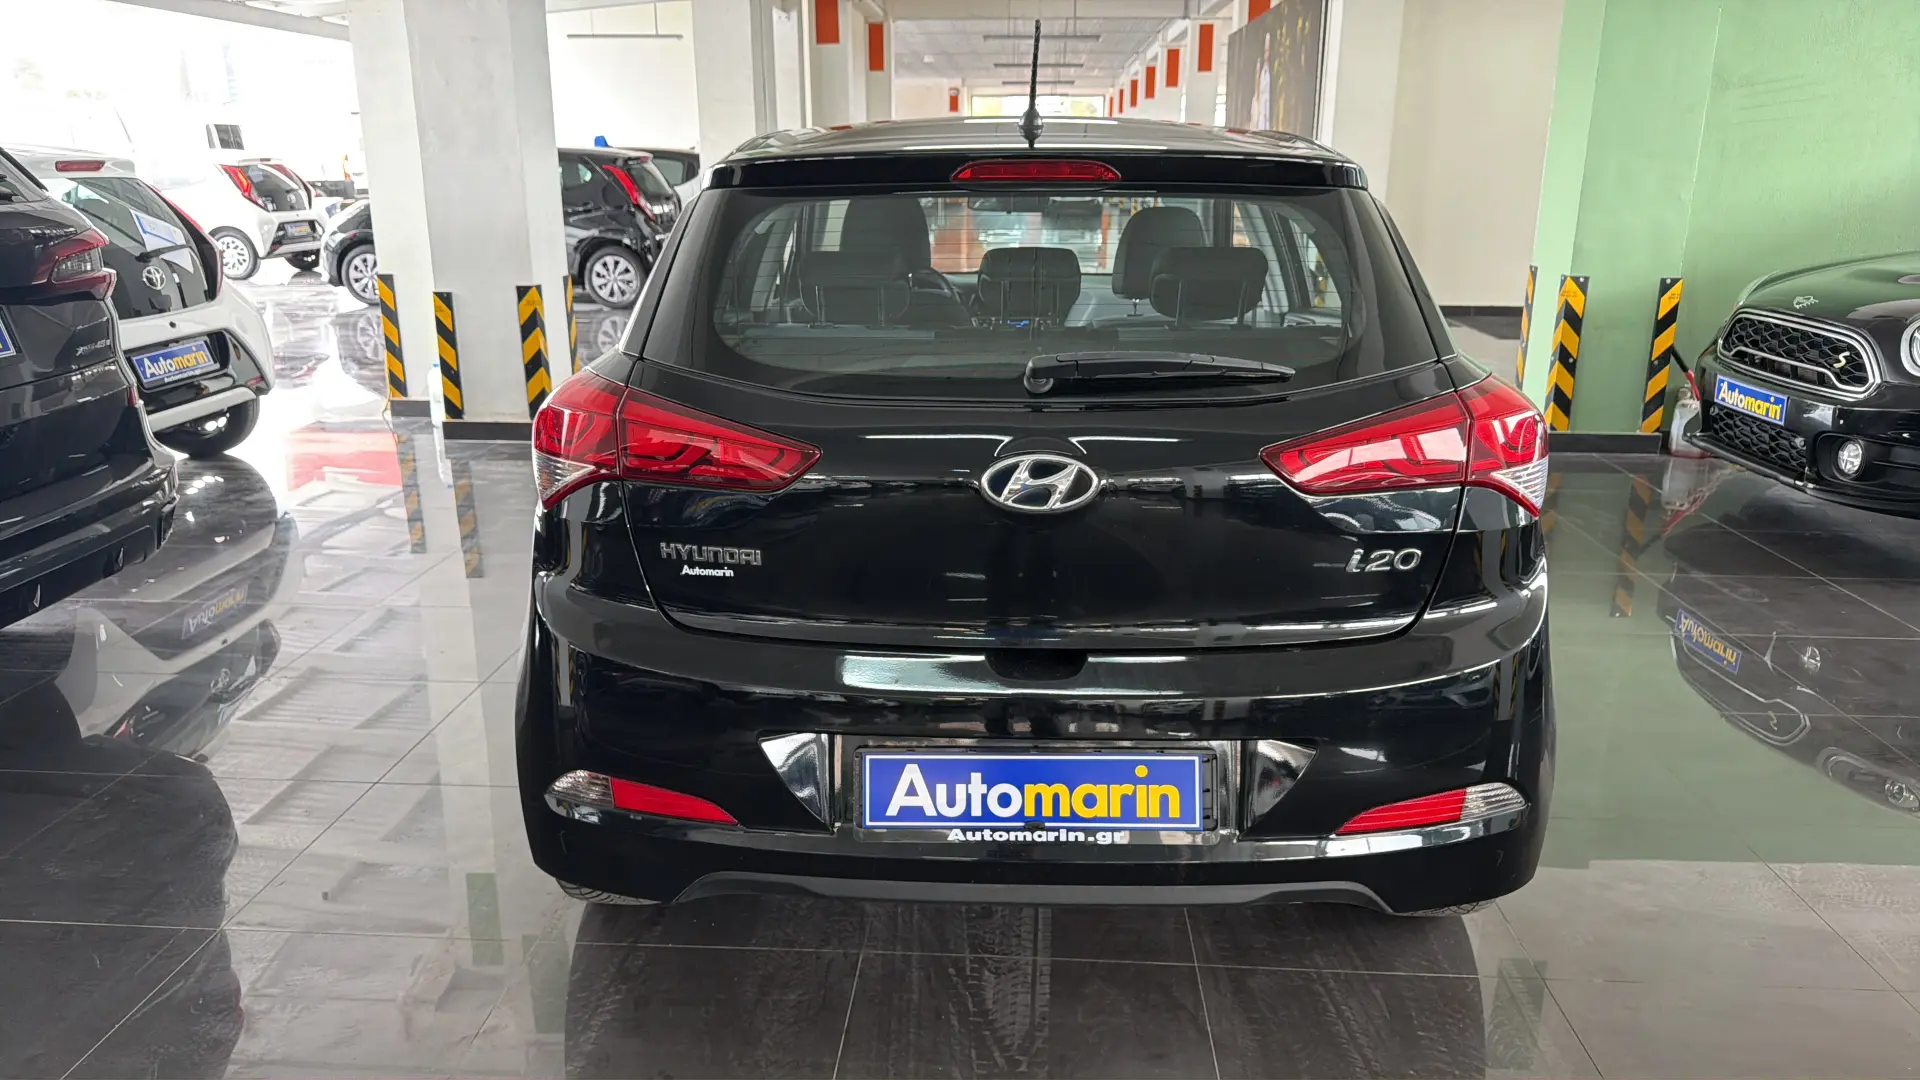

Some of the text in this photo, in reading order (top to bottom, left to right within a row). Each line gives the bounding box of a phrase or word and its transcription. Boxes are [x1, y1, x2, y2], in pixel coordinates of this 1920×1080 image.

[145, 346, 208, 378] Automarin
[1719, 381, 1781, 420] Automarin
[660, 542, 762, 566] HYUNDAI
[1345, 548, 1422, 572] i20
[681, 565, 734, 577] Automarin
[886, 763, 1181, 818] Automarin
[947, 827, 1126, 845] Automarin.gr
